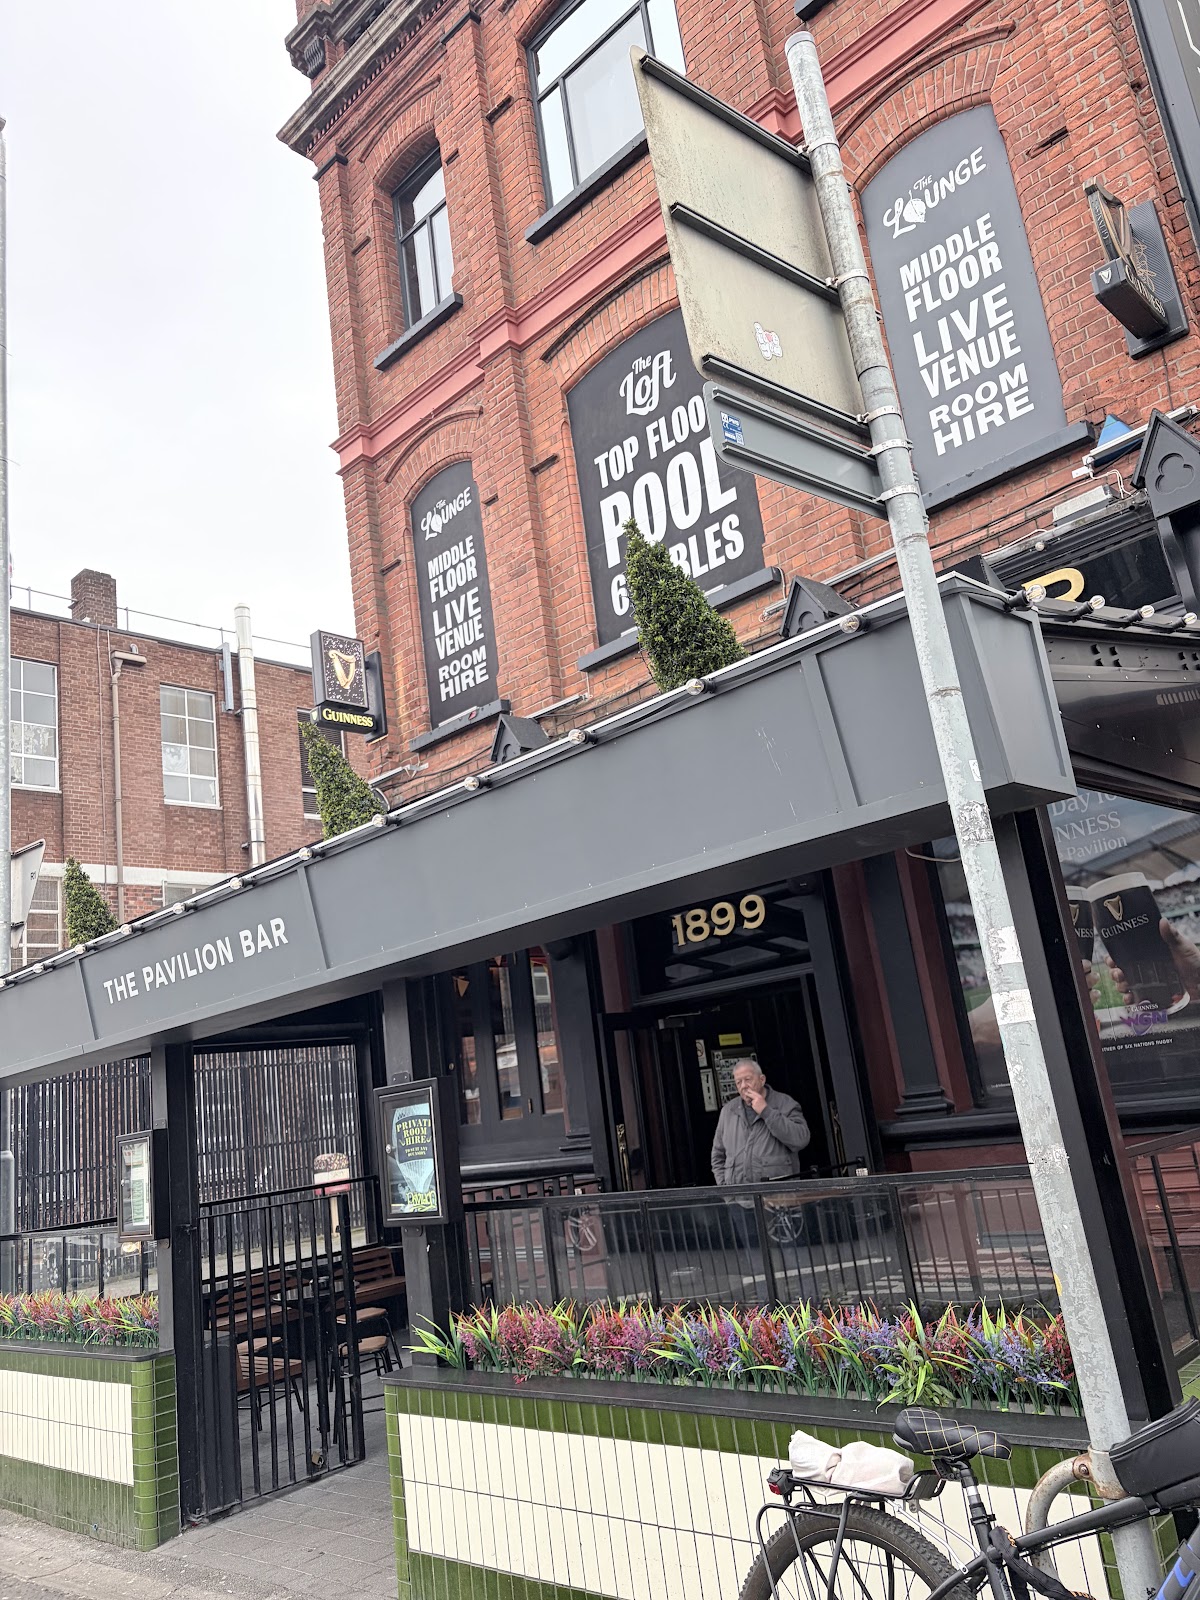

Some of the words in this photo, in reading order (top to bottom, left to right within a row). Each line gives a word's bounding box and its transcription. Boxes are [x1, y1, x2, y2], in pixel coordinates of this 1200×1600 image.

[899, 212, 996, 291] MIDDLE
[904, 241, 1003, 323] FLOOR
[912, 282, 1014, 368] LIVE
[619, 350, 677, 415] Loft
[632, 355, 651, 375] The
[920, 320, 1022, 399] VENUE
[928, 362, 1029, 431] ROOM
[593, 435, 639, 489] TOP
[645, 394, 706, 460] FLOO
[932, 385, 1036, 457] HIRE
[599, 436, 738, 570] POOL
[427, 535, 475, 580] MIDDLE
[429, 556, 478, 603] FLOOR
[611, 573, 630, 616] 6
[668, 513, 745, 579] BLES
[432, 587, 482, 636] LIVE
[435, 615, 485, 660] VENUE
[438, 645, 487, 683] ROOM
[440, 662, 489, 702] HIRE
[322, 708, 374, 727] GUINNESS
[1055, 811, 1121, 843] NNESS
[1066, 836, 1128, 860] Pavilion
[672, 894, 766, 946] 1899
[1101, 914, 1149, 939] GUINNESS
[103, 971, 139, 1004] THE
[142, 936, 234, 991] PAVILION
[239, 917, 289, 958] BAR
[1131, 1003, 1159, 1012] GUINNESS
[403, 1128, 427, 1138] ROOM
[405, 1135, 427, 1146] HIRE
